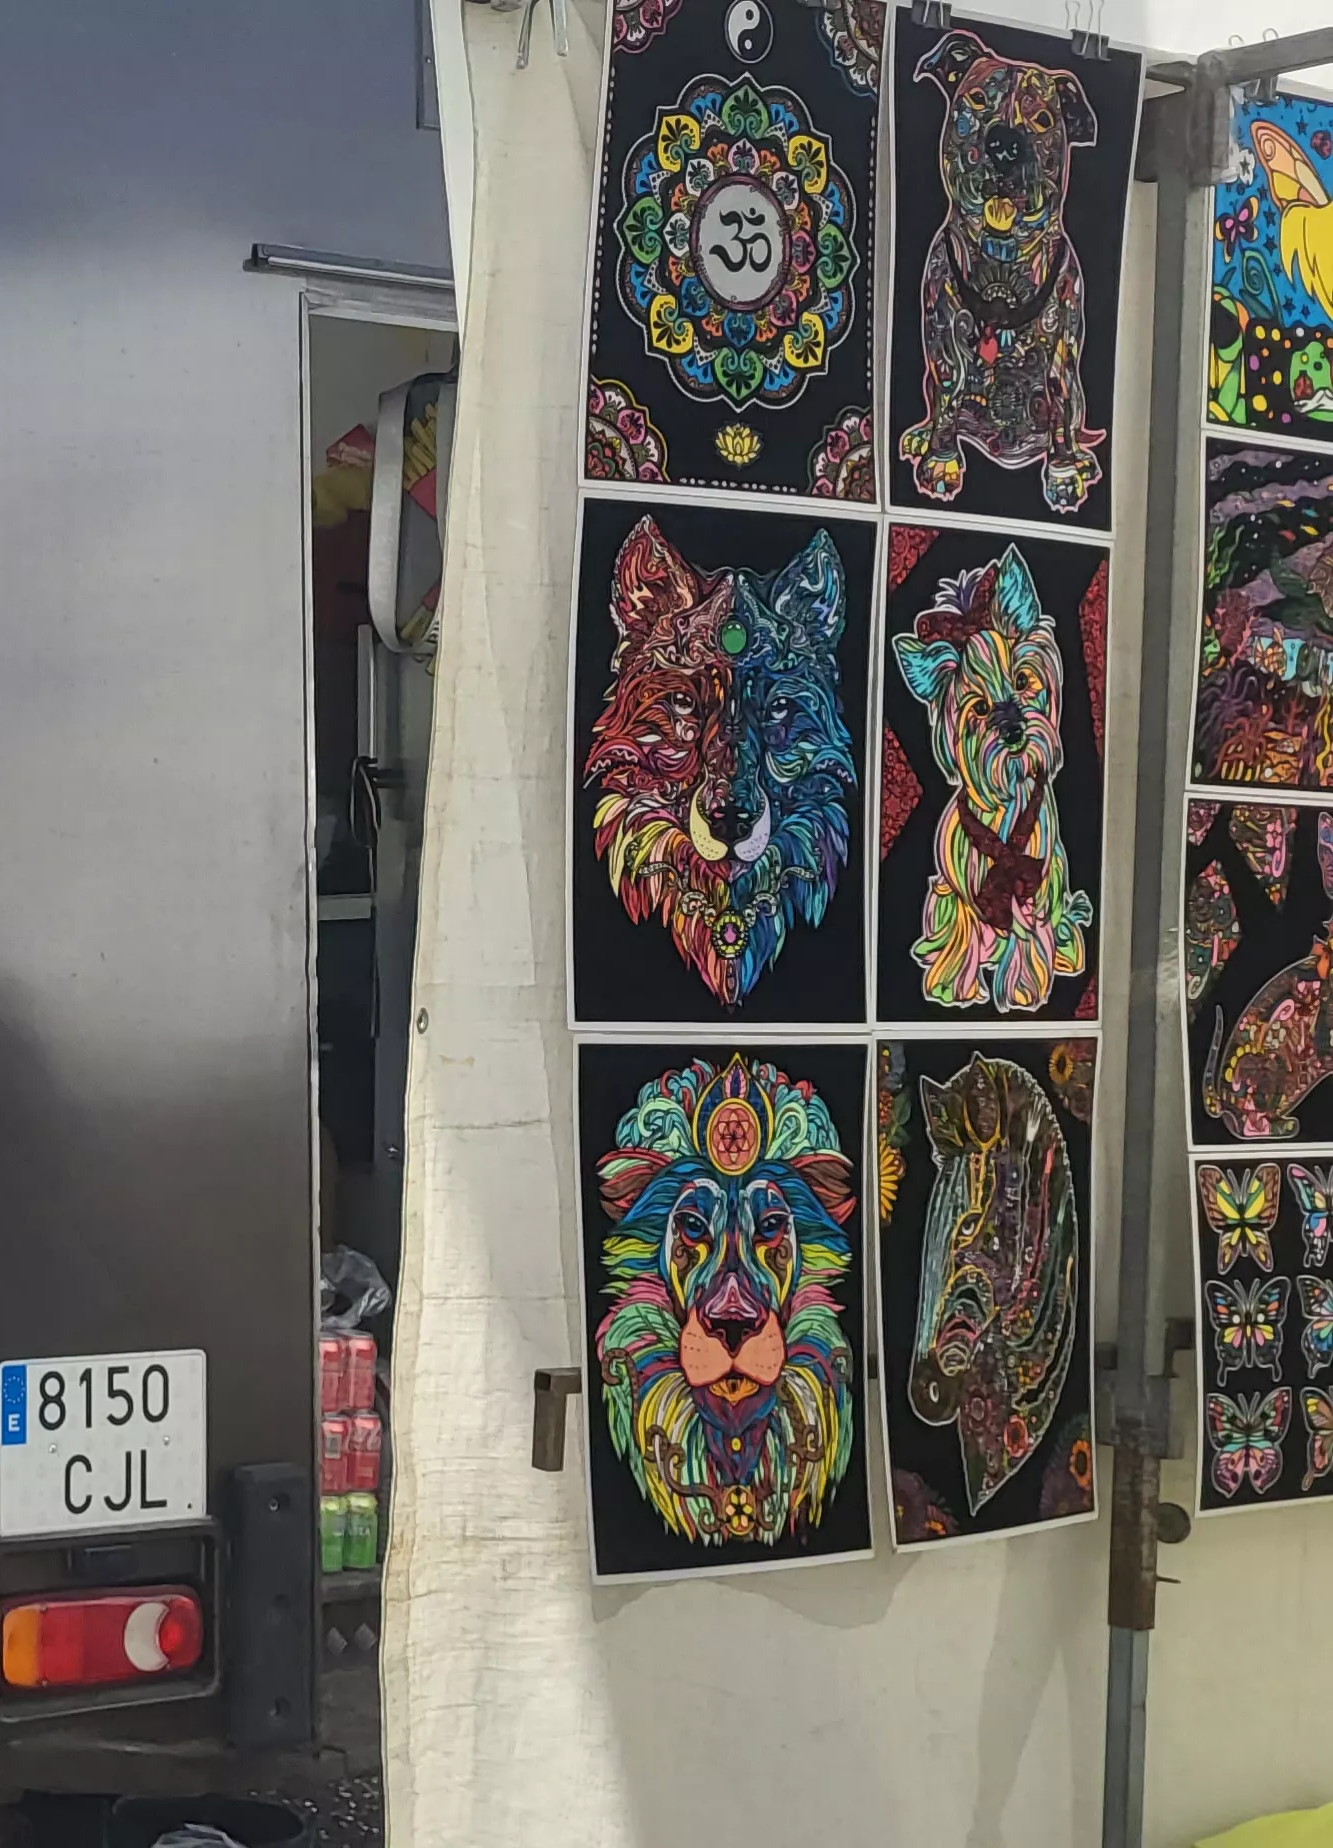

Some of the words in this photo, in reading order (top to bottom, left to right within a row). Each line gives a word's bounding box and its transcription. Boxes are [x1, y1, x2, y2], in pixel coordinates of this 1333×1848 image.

[8, 1414, 20, 1432] E
[38, 1364, 169, 1431] 8150
[64, 1449, 168, 1515] CJL
